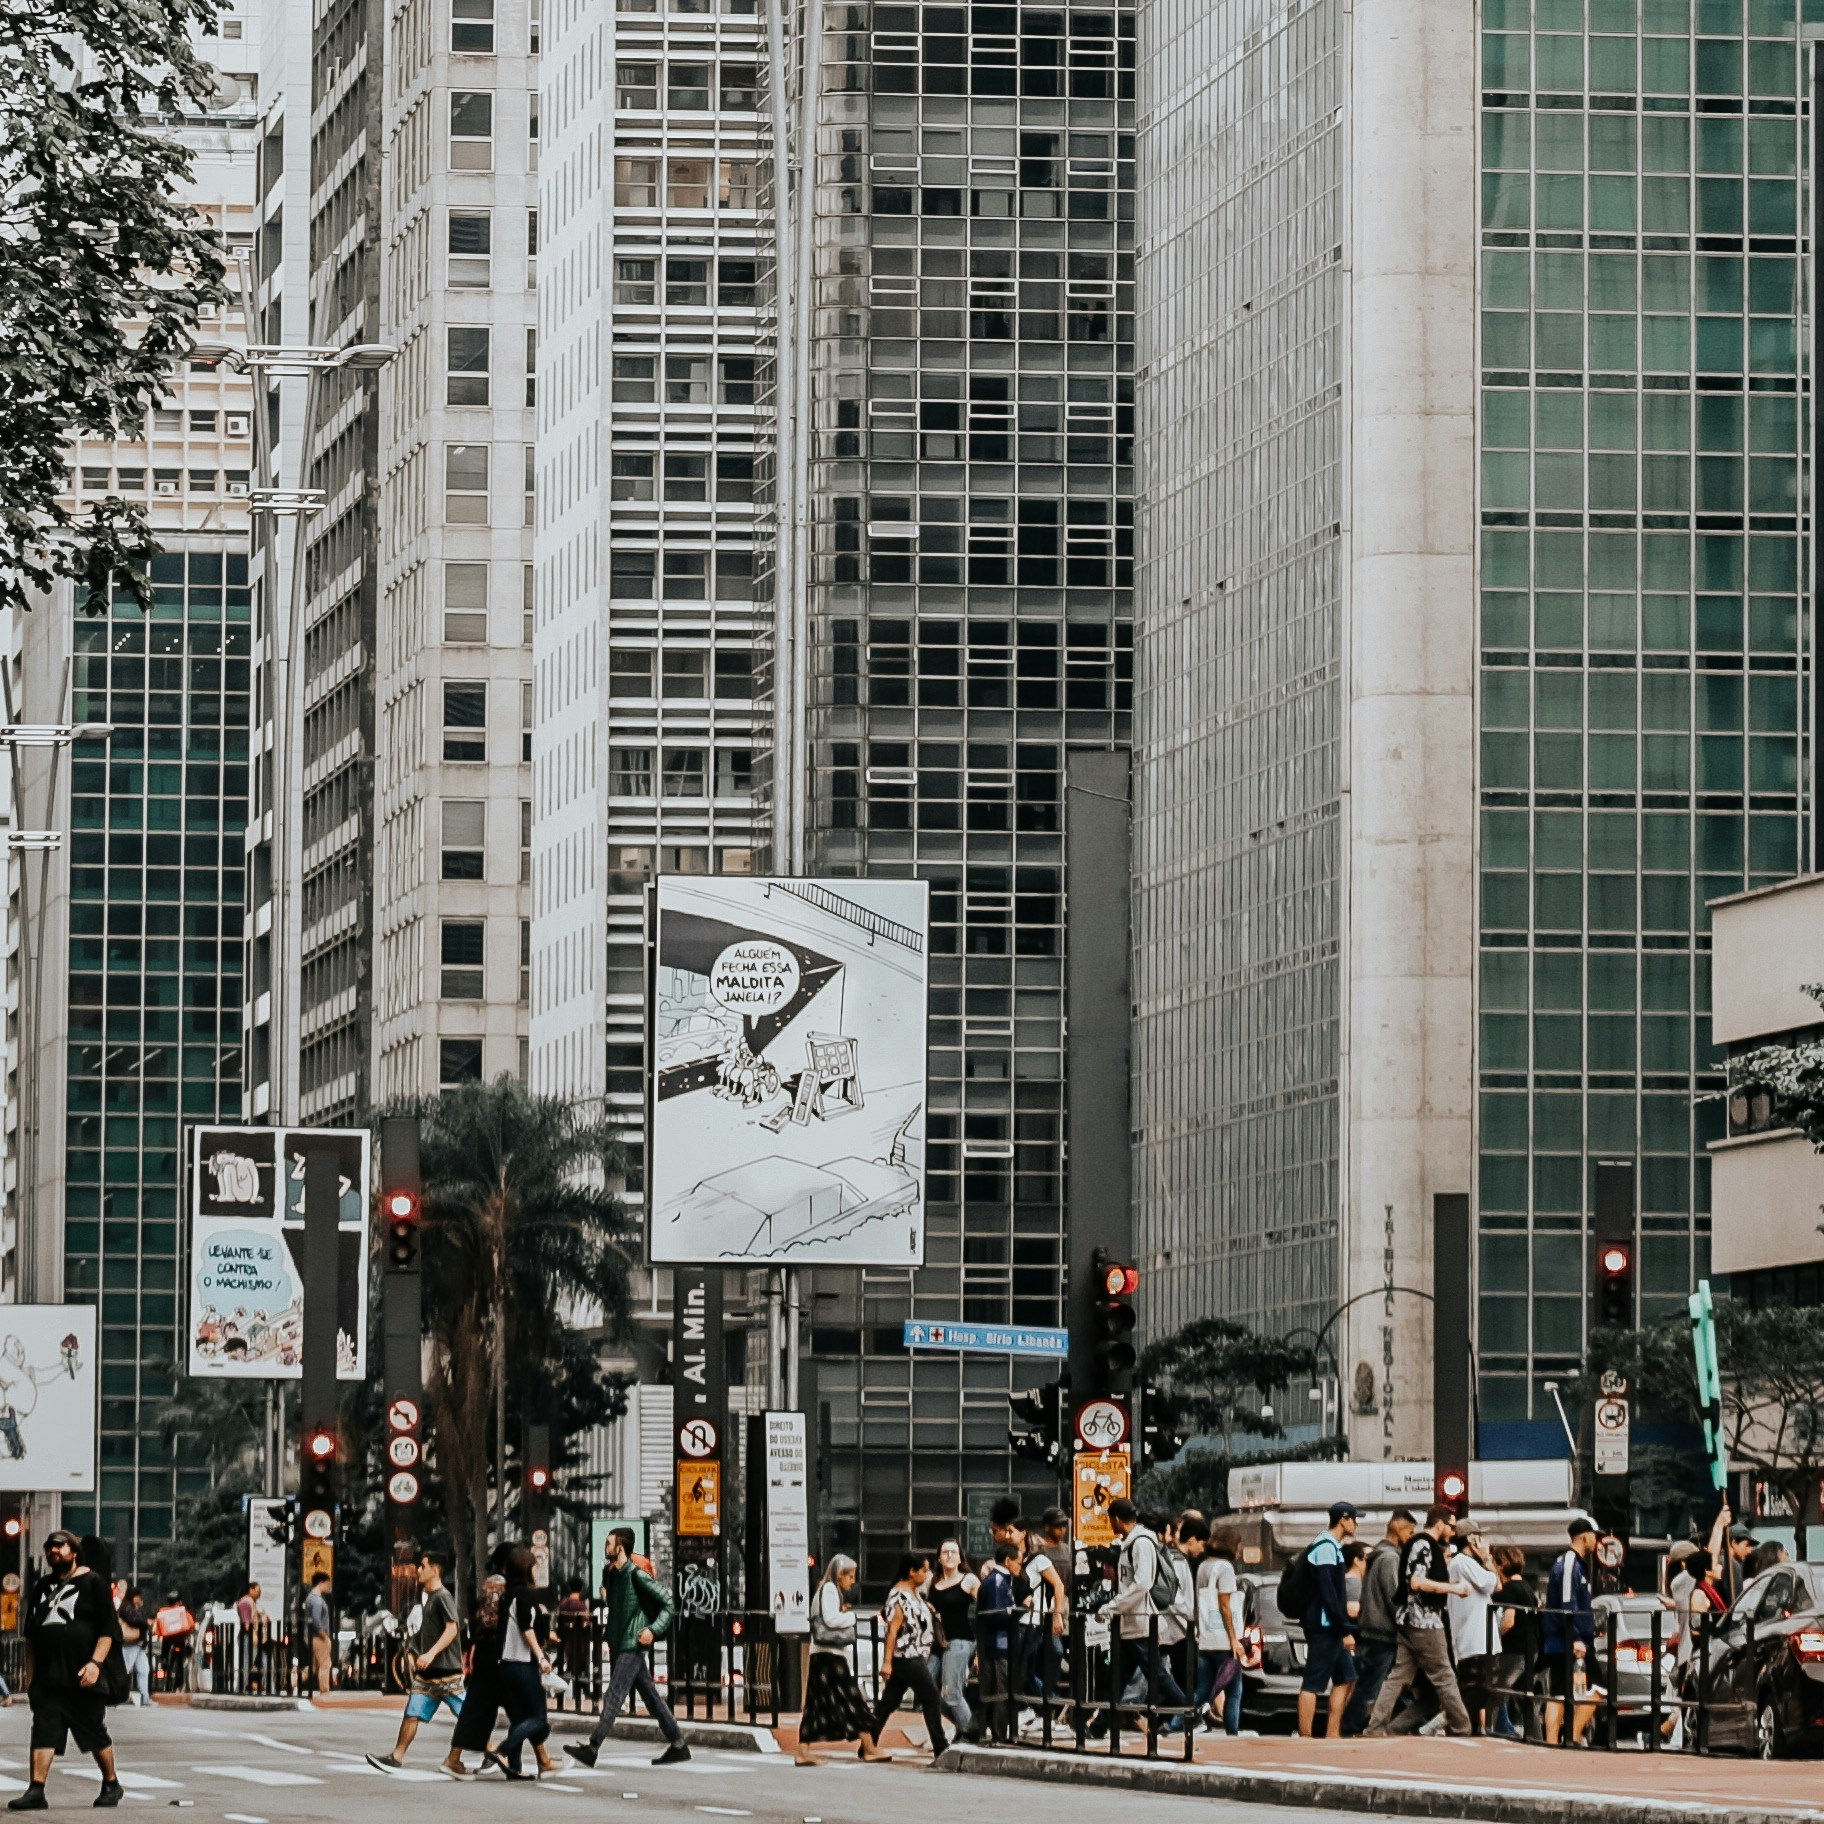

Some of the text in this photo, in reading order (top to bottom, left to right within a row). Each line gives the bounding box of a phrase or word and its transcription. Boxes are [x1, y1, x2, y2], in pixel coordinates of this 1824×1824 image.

[734, 946, 781, 960] ALGUÉM
[722, 962, 792, 973] FECHA ESSA
[716, 976, 785, 989] MALDITA
[217, 1262, 258, 1277] CONTRA
[203, 1276, 212, 1288] O
[682, 1282, 706, 1386] Al. Min.
